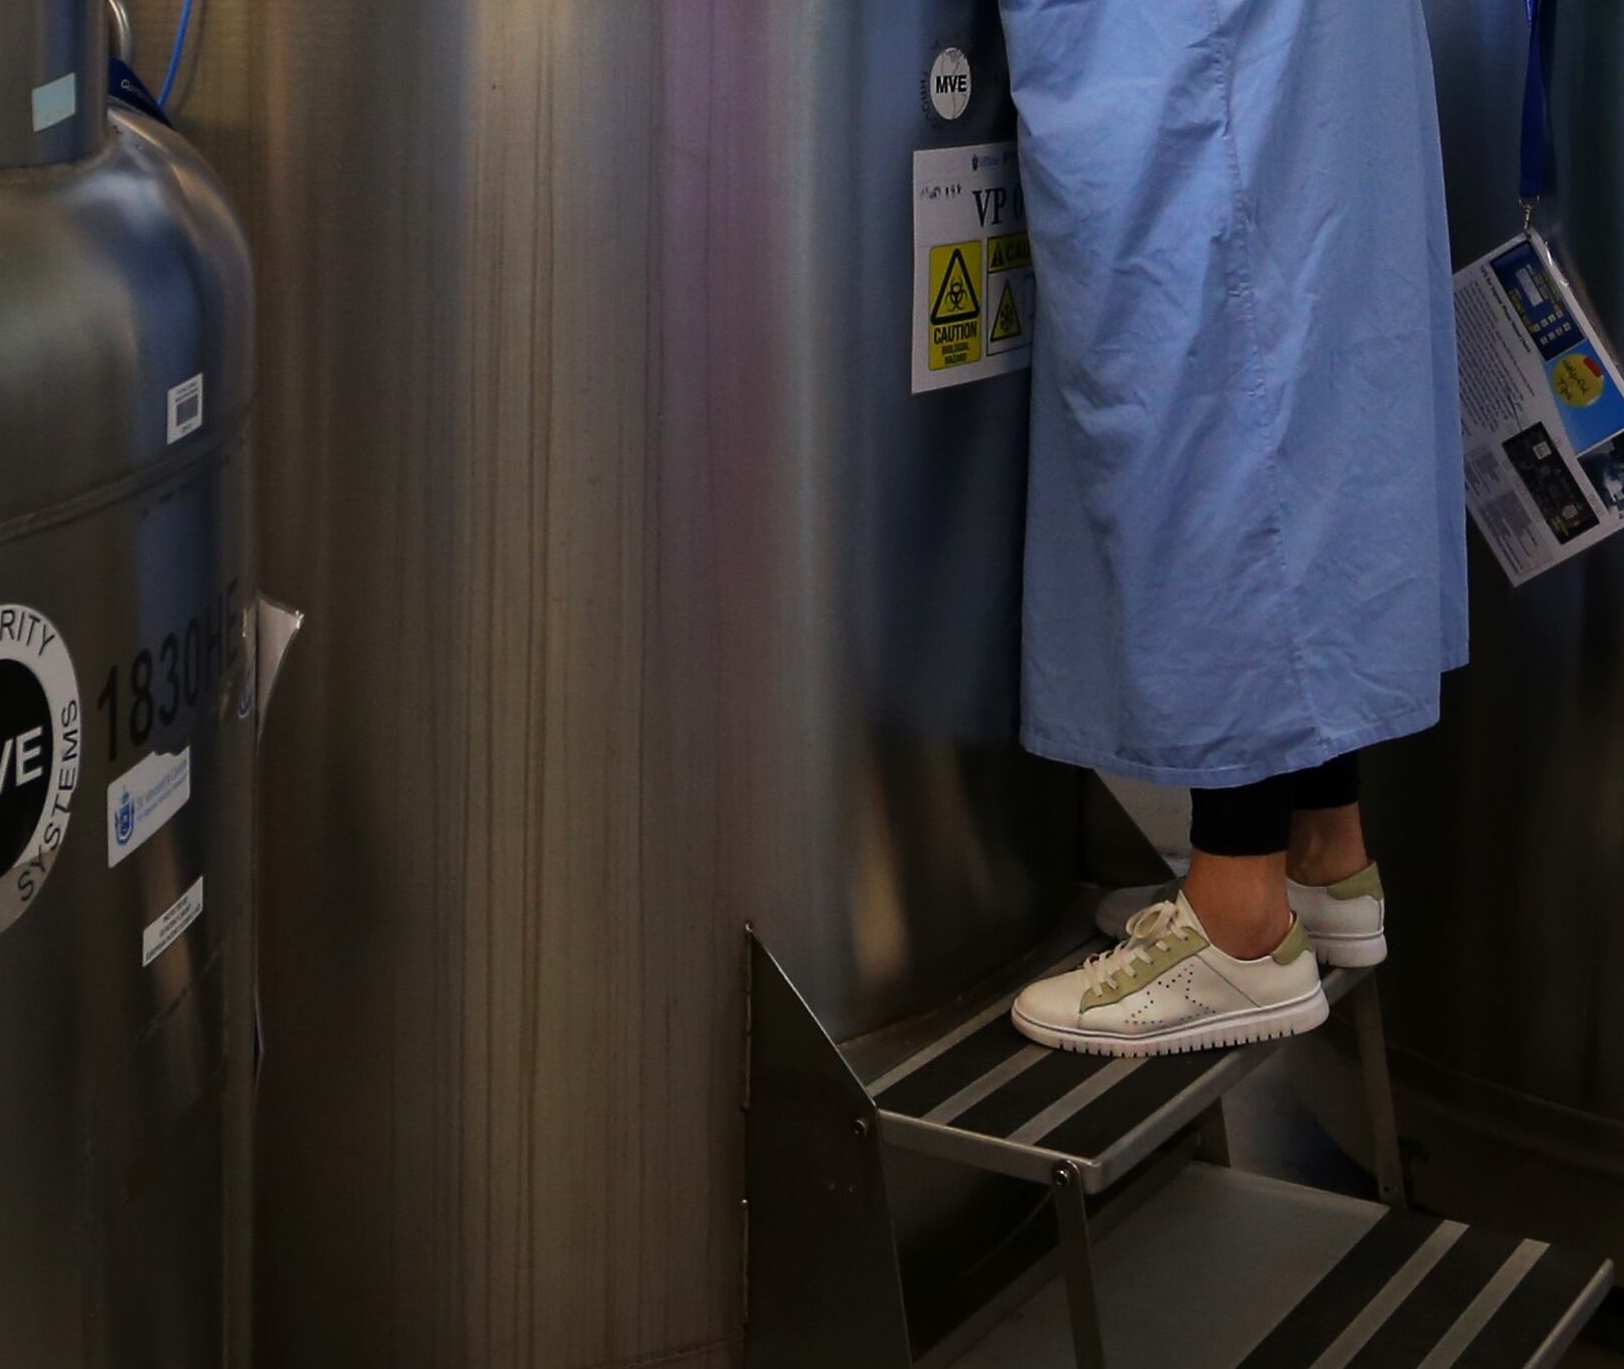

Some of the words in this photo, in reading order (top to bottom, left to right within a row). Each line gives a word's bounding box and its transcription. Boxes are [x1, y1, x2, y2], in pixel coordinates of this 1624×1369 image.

[936, 75, 967, 94] MVE
[972, 185, 1008, 229] VP
[934, 322, 978, 345] CAUTION
[17, 699, 77, 902] SYSTEMS
